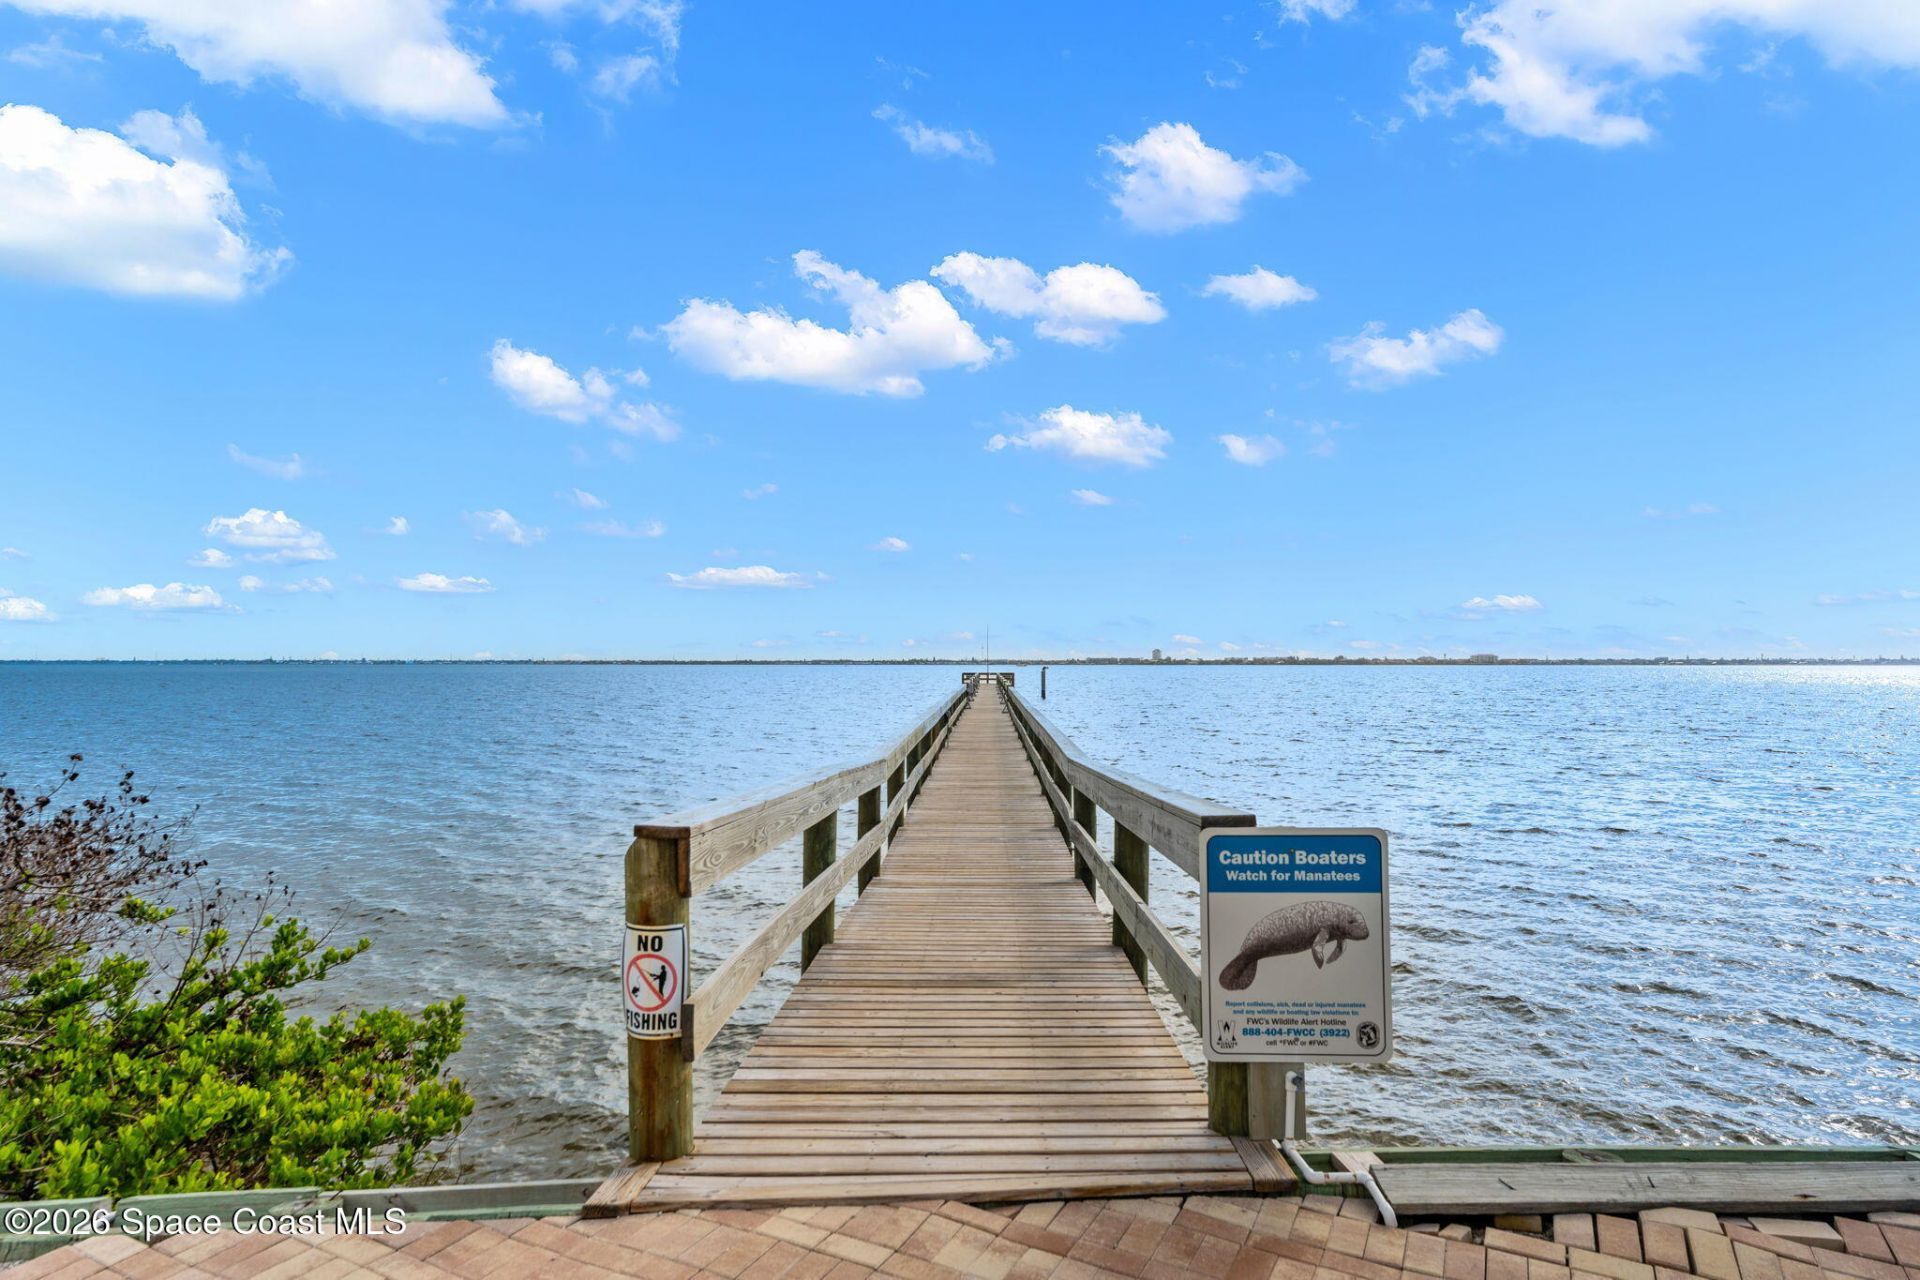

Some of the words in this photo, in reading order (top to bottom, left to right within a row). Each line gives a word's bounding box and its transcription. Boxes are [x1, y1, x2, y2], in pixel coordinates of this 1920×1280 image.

[1219, 850, 1289, 865] Caution
[1295, 850, 1367, 865] Boaters
[1226, 870, 1267, 881] Watch
[1271, 870, 1291, 881] for
[1294, 870, 1361, 882] Manatees
[637, 935, 664, 952] NO
[626, 1009, 678, 1031] FISHING
[1271, 1018, 1299, 1026] Wildlife
[1242, 1028, 1316, 1037] 888-404-FWCC
[1320, 1029, 1350, 1038] (3922)
